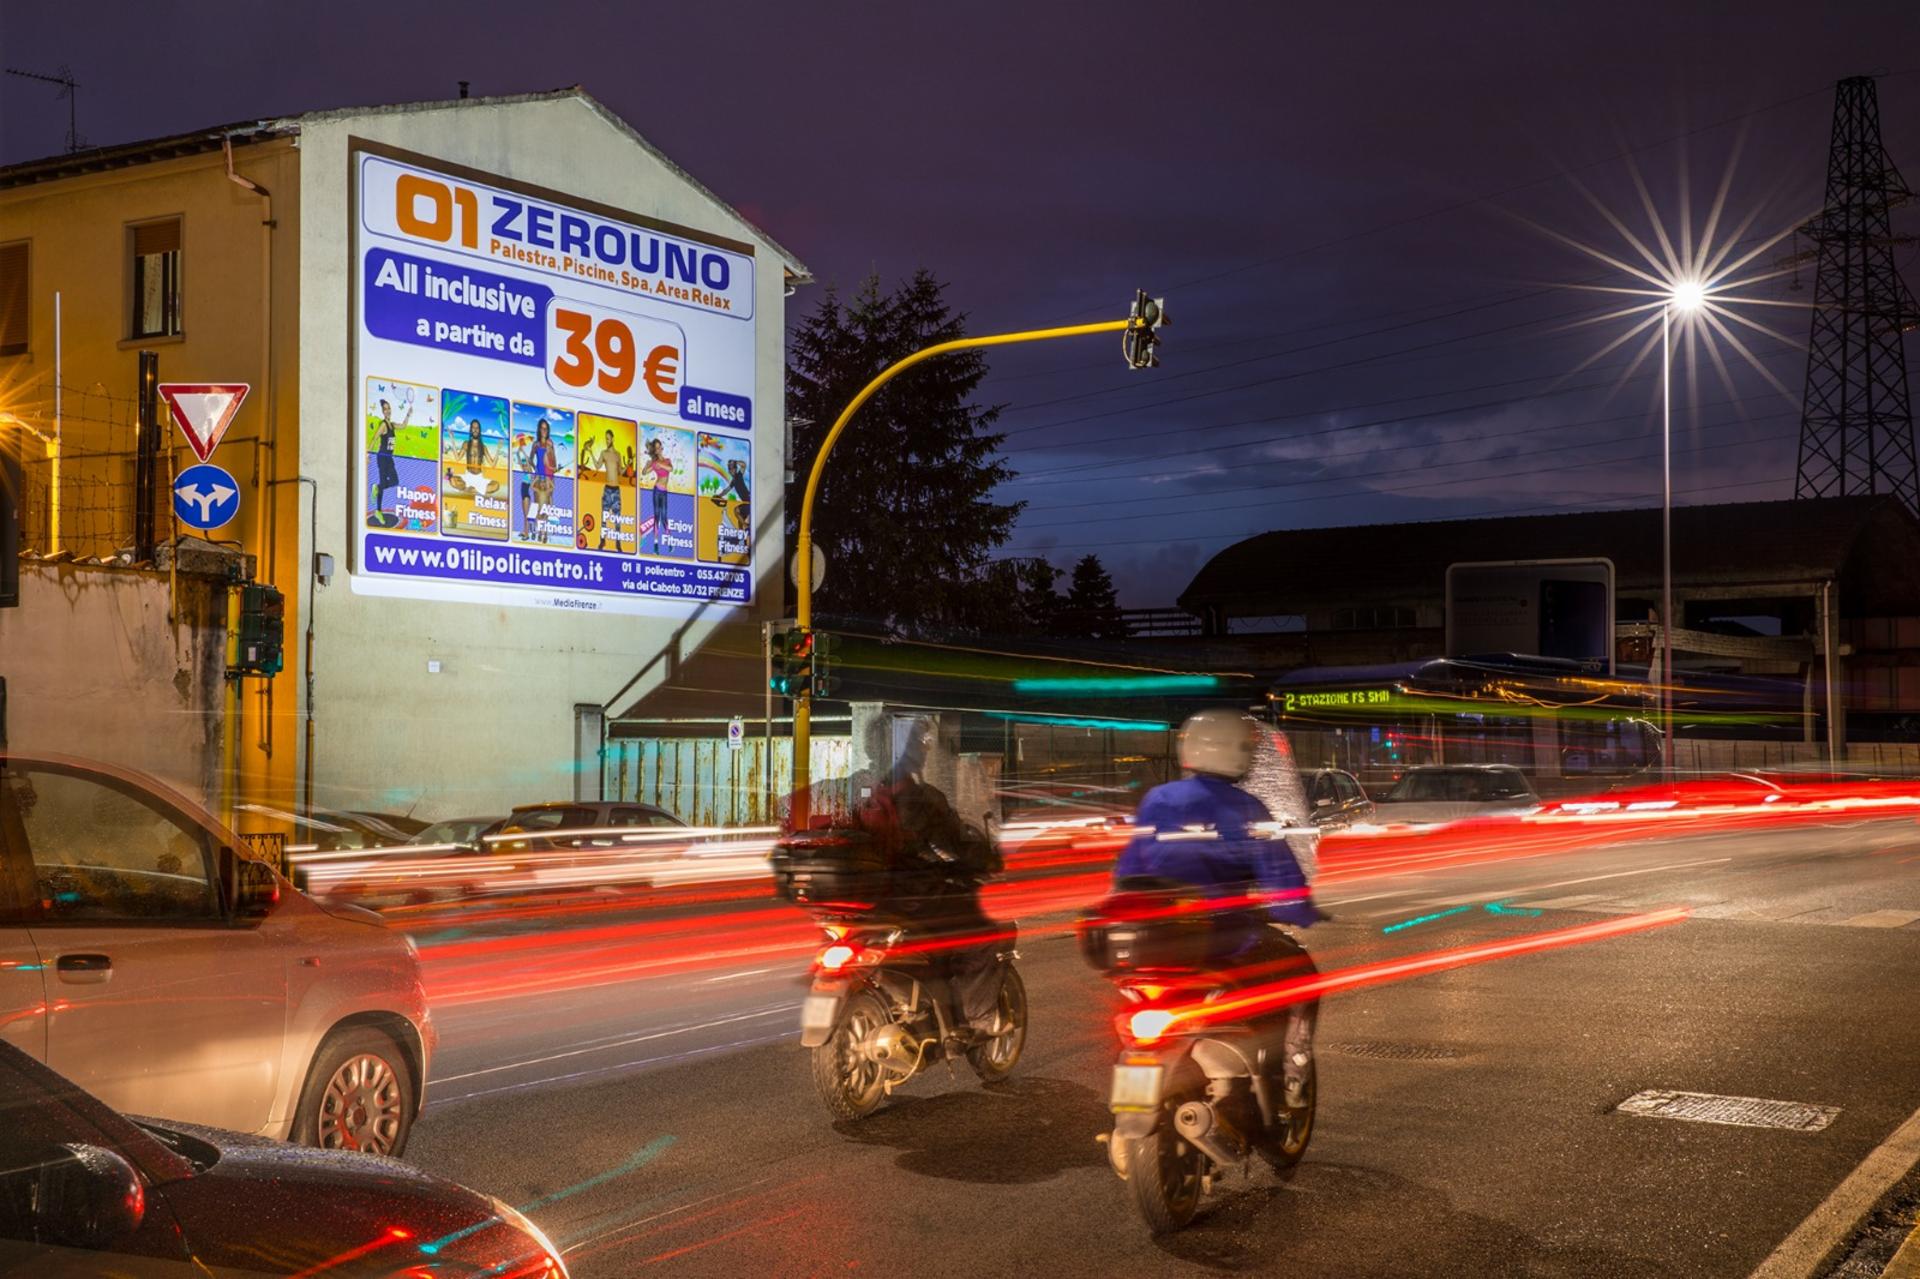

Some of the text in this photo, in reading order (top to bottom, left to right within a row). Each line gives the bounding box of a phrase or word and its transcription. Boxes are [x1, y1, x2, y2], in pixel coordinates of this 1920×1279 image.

[396, 174, 730, 291] 01 ZEROUNO
[490, 238, 731, 310] Palestra, Piscine, Spa, Area Relax
[374, 258, 535, 319] All inclusive
[416, 318, 535, 357] a partire da
[687, 395, 745, 422] al mese
[396, 486, 436, 504] Happy
[475, 495, 506, 511] Relax
[395, 504, 436, 520] Fitness
[540, 503, 573, 519] Acqua
[602, 511, 635, 525] Power
[468, 512, 506, 528] Fitness
[537, 520, 573, 535] Fitness
[668, 519, 693, 533] Enjoy
[601, 527, 634, 541] Fitness
[718, 525, 749, 540] Energy
[661, 534, 693, 548] Fitness
[718, 541, 749, 554] Fitness
[374, 545, 603, 582] www.01ilpolicentro.it
[621, 562, 632, 573] 01
[645, 565, 685, 578] policentro
[622, 578, 635, 590] via
[650, 581, 681, 593] Caboto
[682, 584, 708, 596] 30/32
[1286, 693, 1295, 711] 2
[1300, 692, 1349, 706] STAZIONE
[1352, 690, 1365, 704] FS
